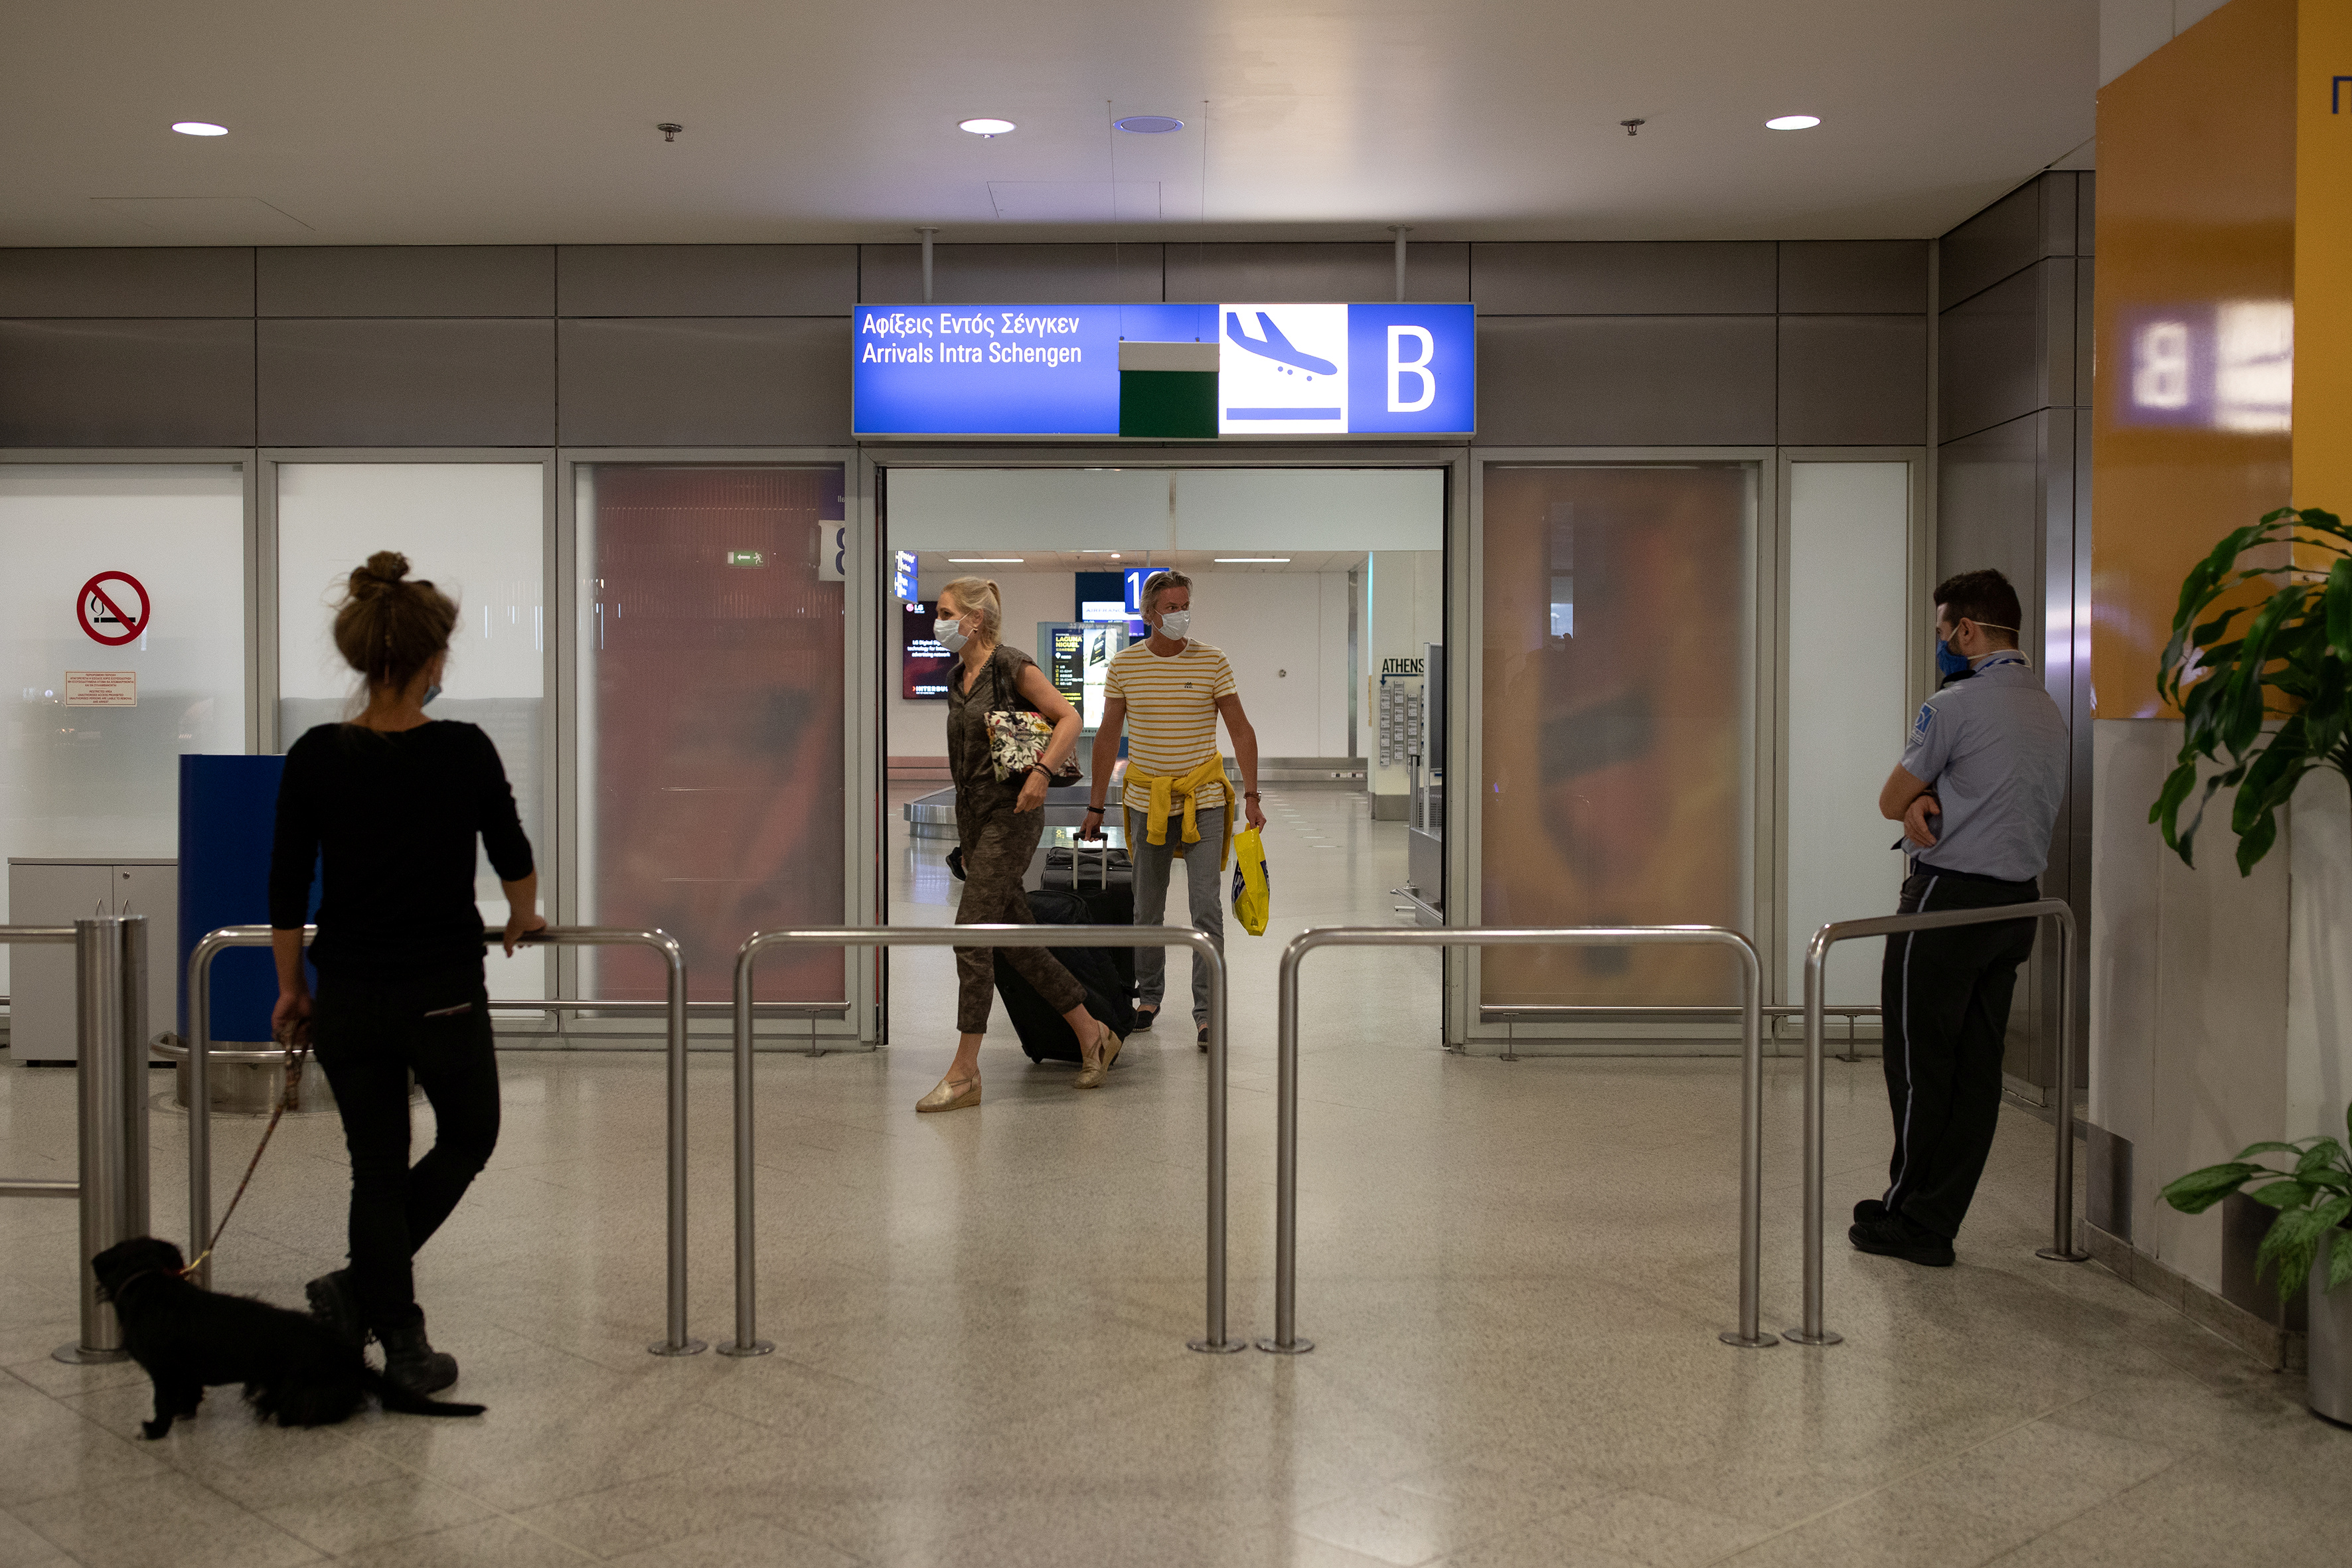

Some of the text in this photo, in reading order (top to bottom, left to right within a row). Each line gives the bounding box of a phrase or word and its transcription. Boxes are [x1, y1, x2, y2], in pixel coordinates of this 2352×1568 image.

[862, 313, 1079, 339] Αφίξεις Εντός Σένγκεν
[862, 341, 1081, 368] Arrivals Intra Schengen
[1387, 325, 1436, 413] B
[1382, 659, 1424, 672] ATHENS
